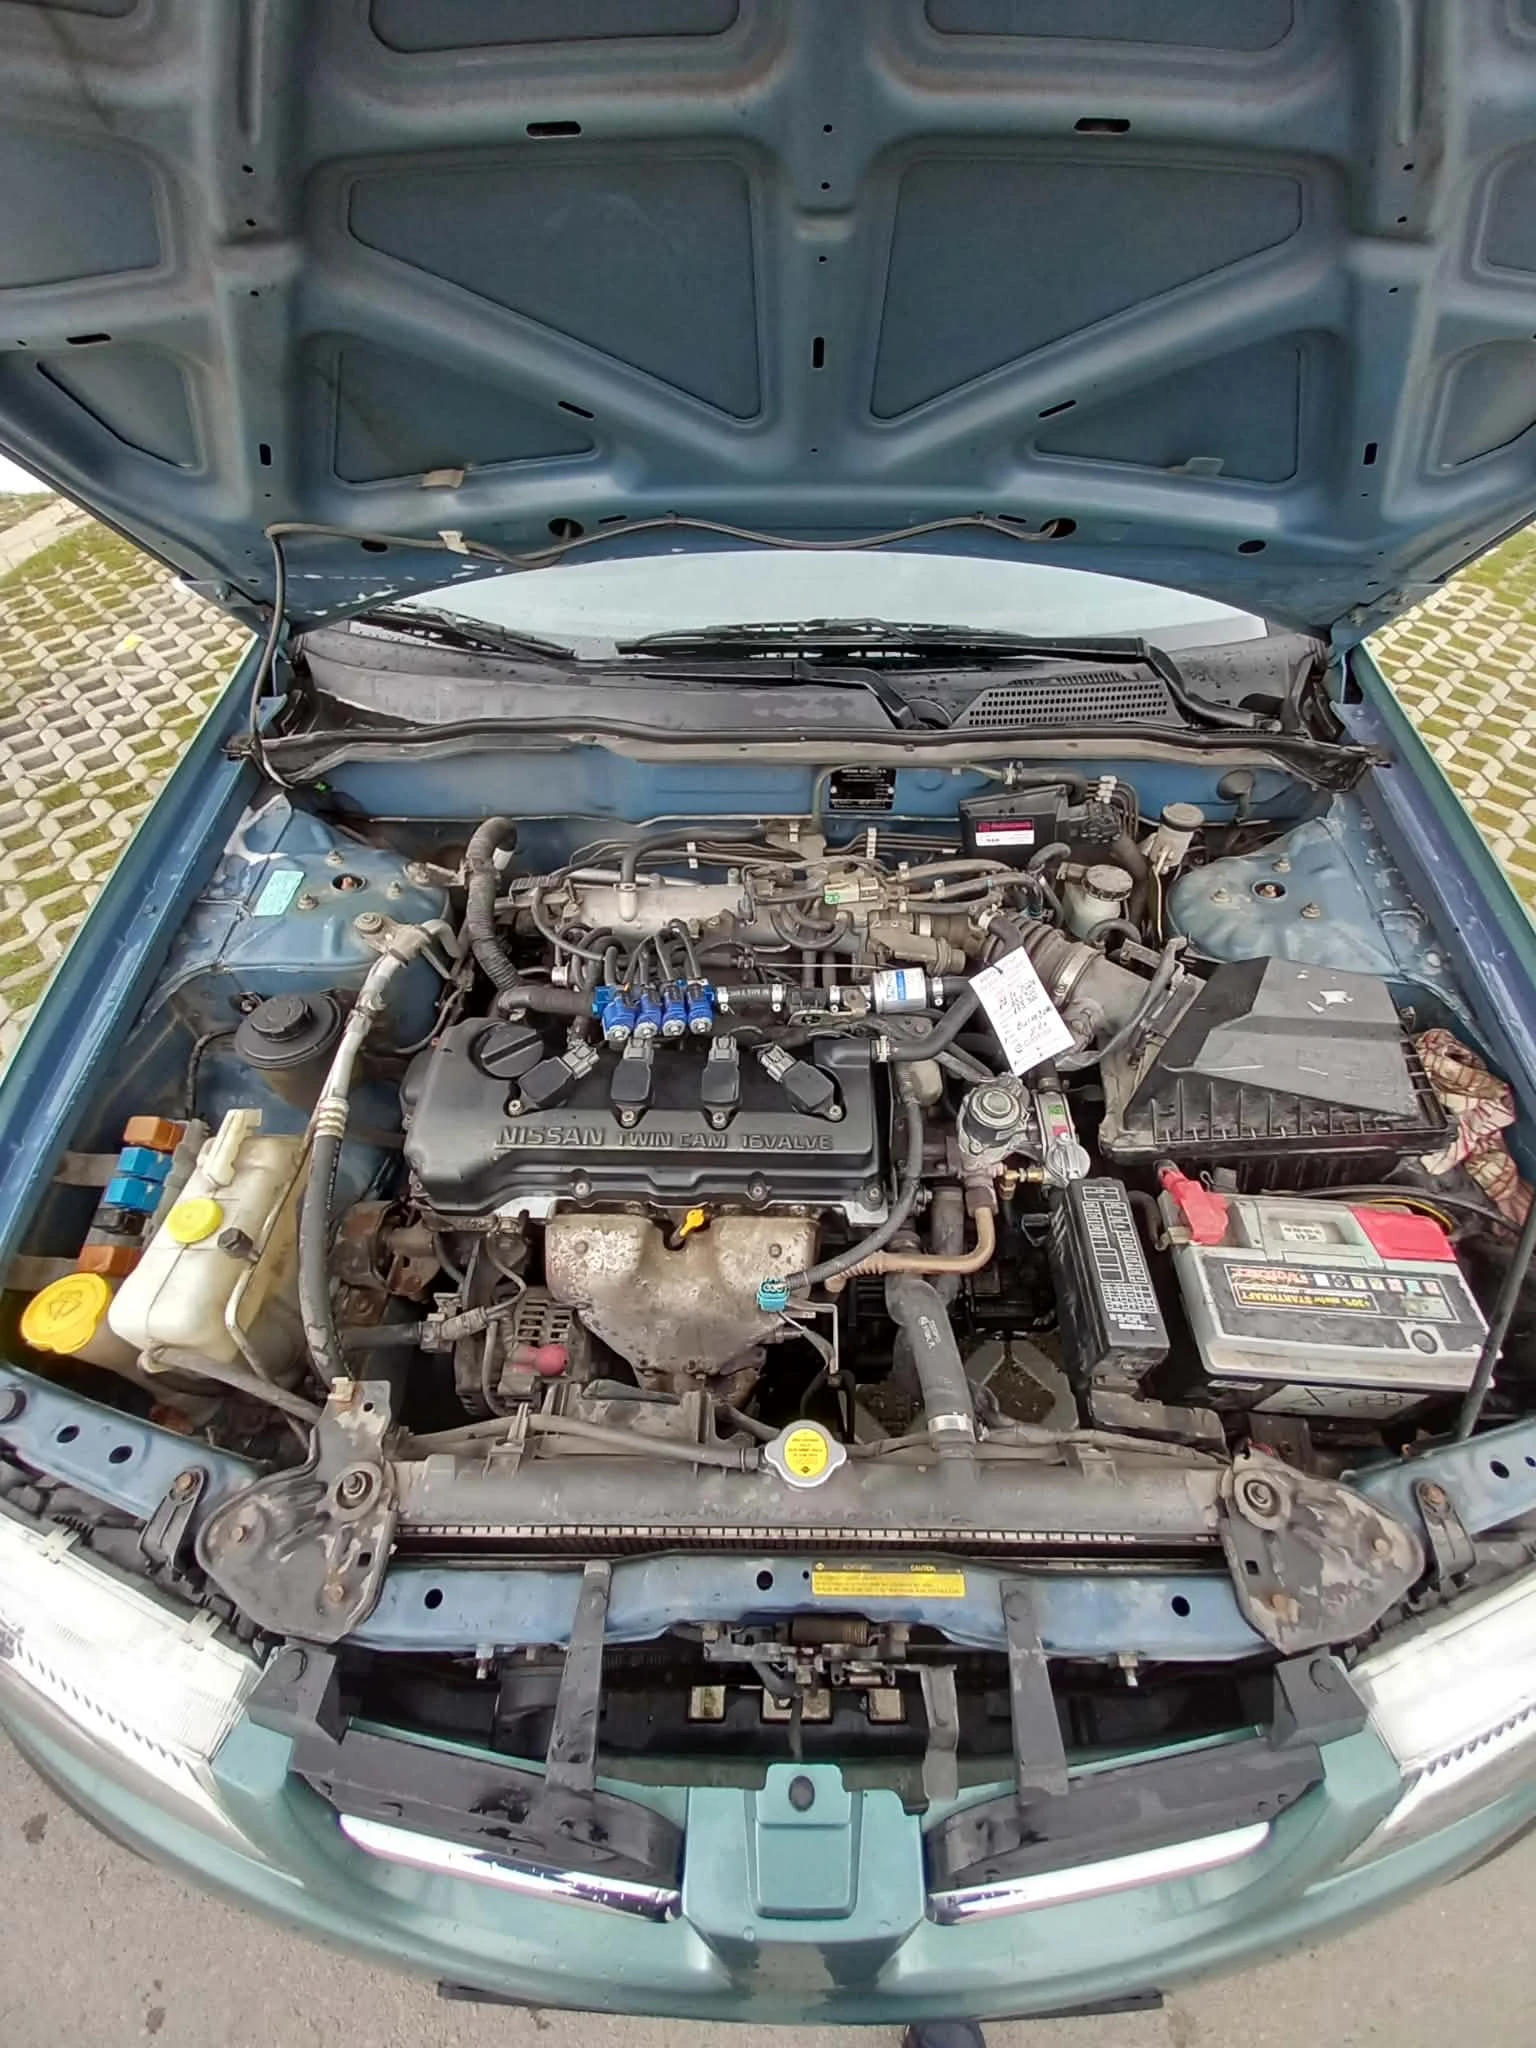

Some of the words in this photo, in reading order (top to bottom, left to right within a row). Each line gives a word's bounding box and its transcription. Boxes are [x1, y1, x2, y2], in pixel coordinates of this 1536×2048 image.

[499, 1126, 605, 1146] NISSAN
[616, 1132, 673, 1148] TWIN
[679, 1133, 728, 1149] CAM
[741, 1134, 834, 1150] 16VALVE
